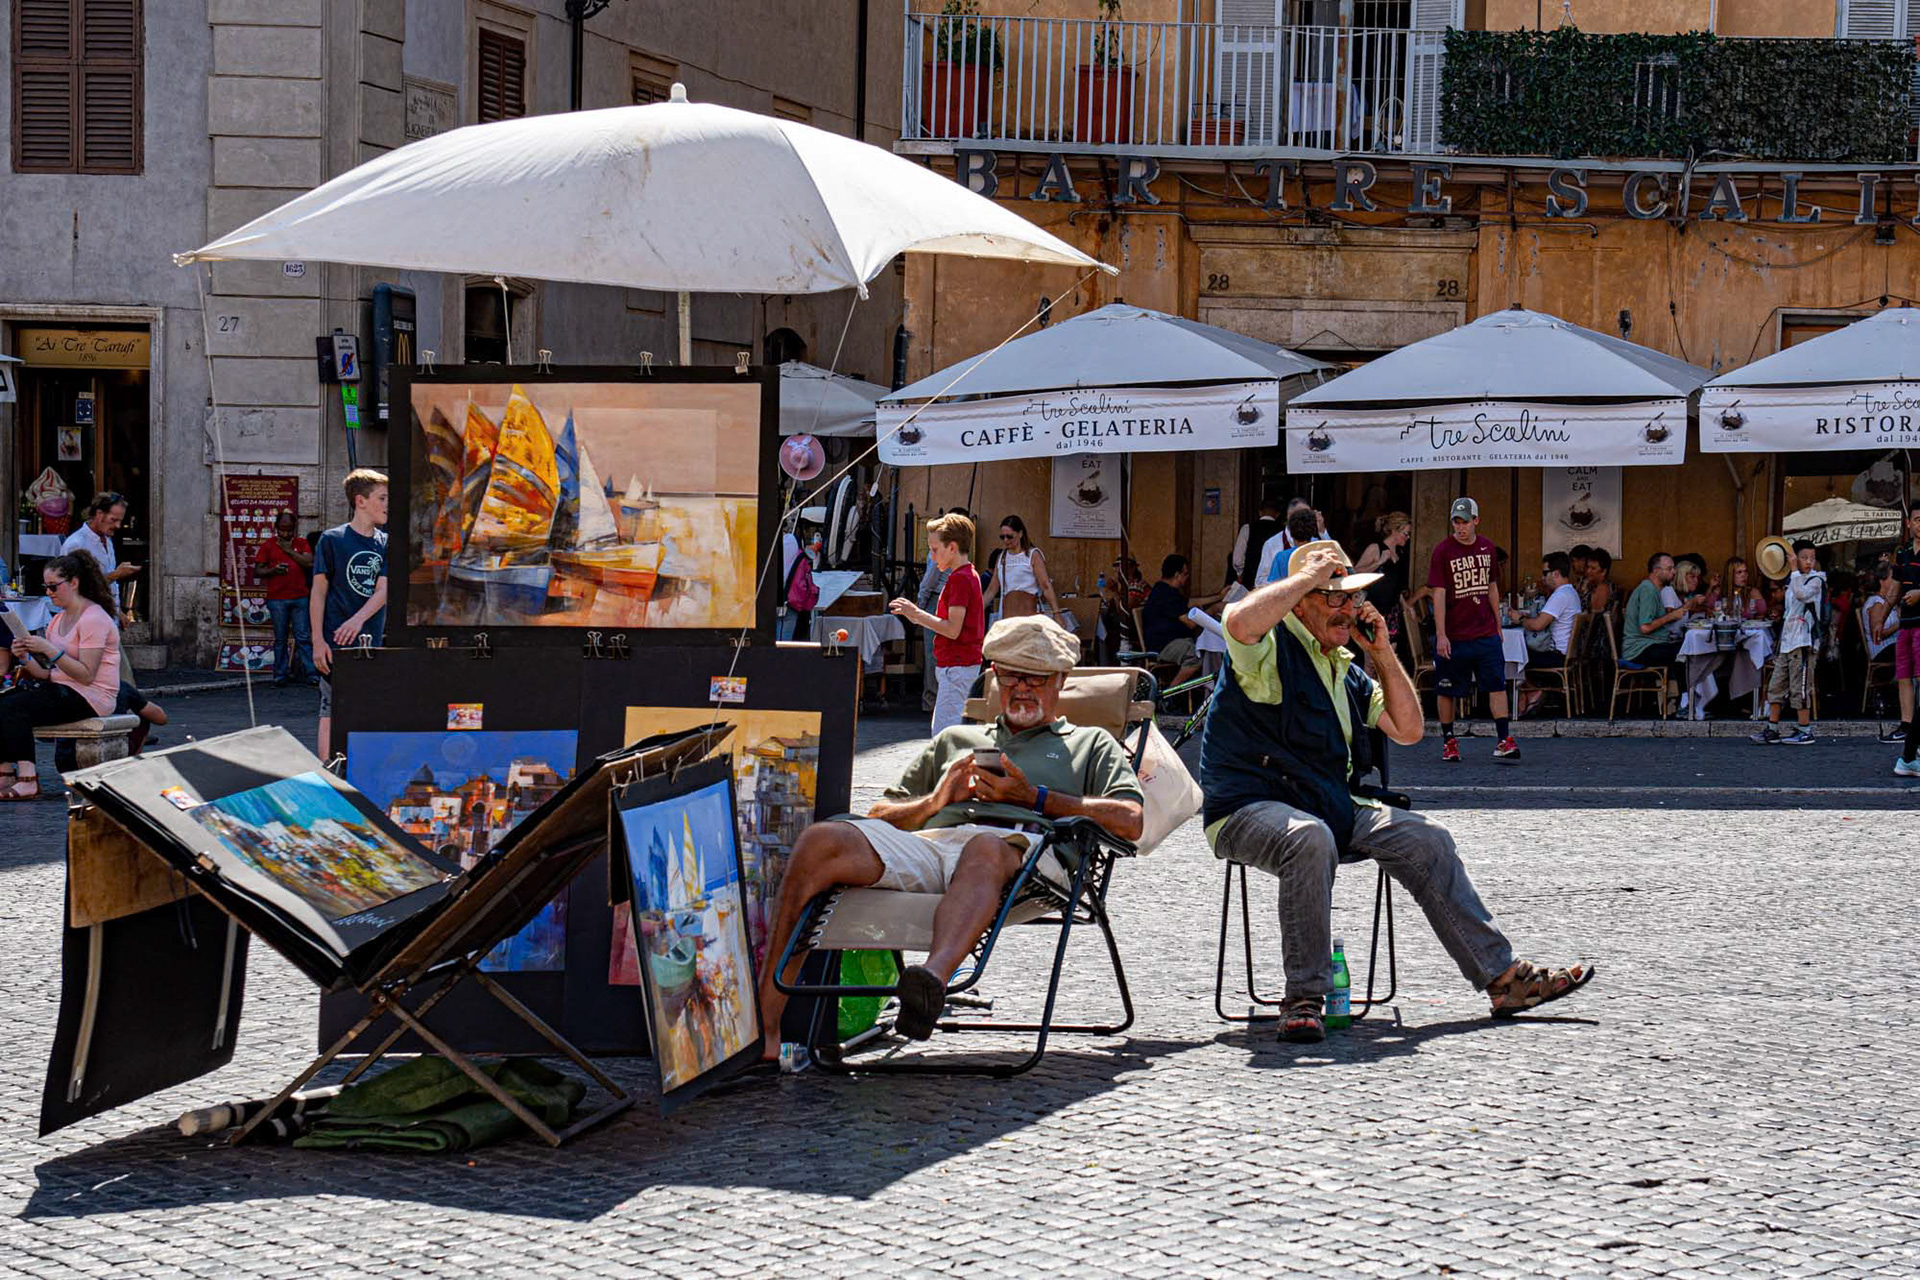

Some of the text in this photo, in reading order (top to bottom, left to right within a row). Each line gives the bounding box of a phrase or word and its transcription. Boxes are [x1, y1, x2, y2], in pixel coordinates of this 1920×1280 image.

[954, 150, 1920, 225] BAR TRE SCALI
[1207, 274, 1230, 290] 28
[1436, 280, 1459, 296] 28
[219, 315, 240, 332] 27
[61, 337, 86, 352] Tre
[1069, 393, 1133, 418] Scalini
[961, 422, 1034, 447] CAFFÈ
[1061, 416, 1194, 439] GELATERIA
[1472, 409, 1571, 445] Scalini
[1815, 415, 1920, 435] RISTOR
[1056, 438, 1104, 450] dal 1946
[1876, 434, 1894, 443] dal
[1082, 460, 1102, 469] EAT
[1433, 454, 1481, 463] RISTORANTE
[1489, 452, 1532, 461] GELATERIA
[1572, 482, 1592, 491] EAT
[350, 565, 371, 575] VANS
[1450, 555, 1475, 573] FEAR
